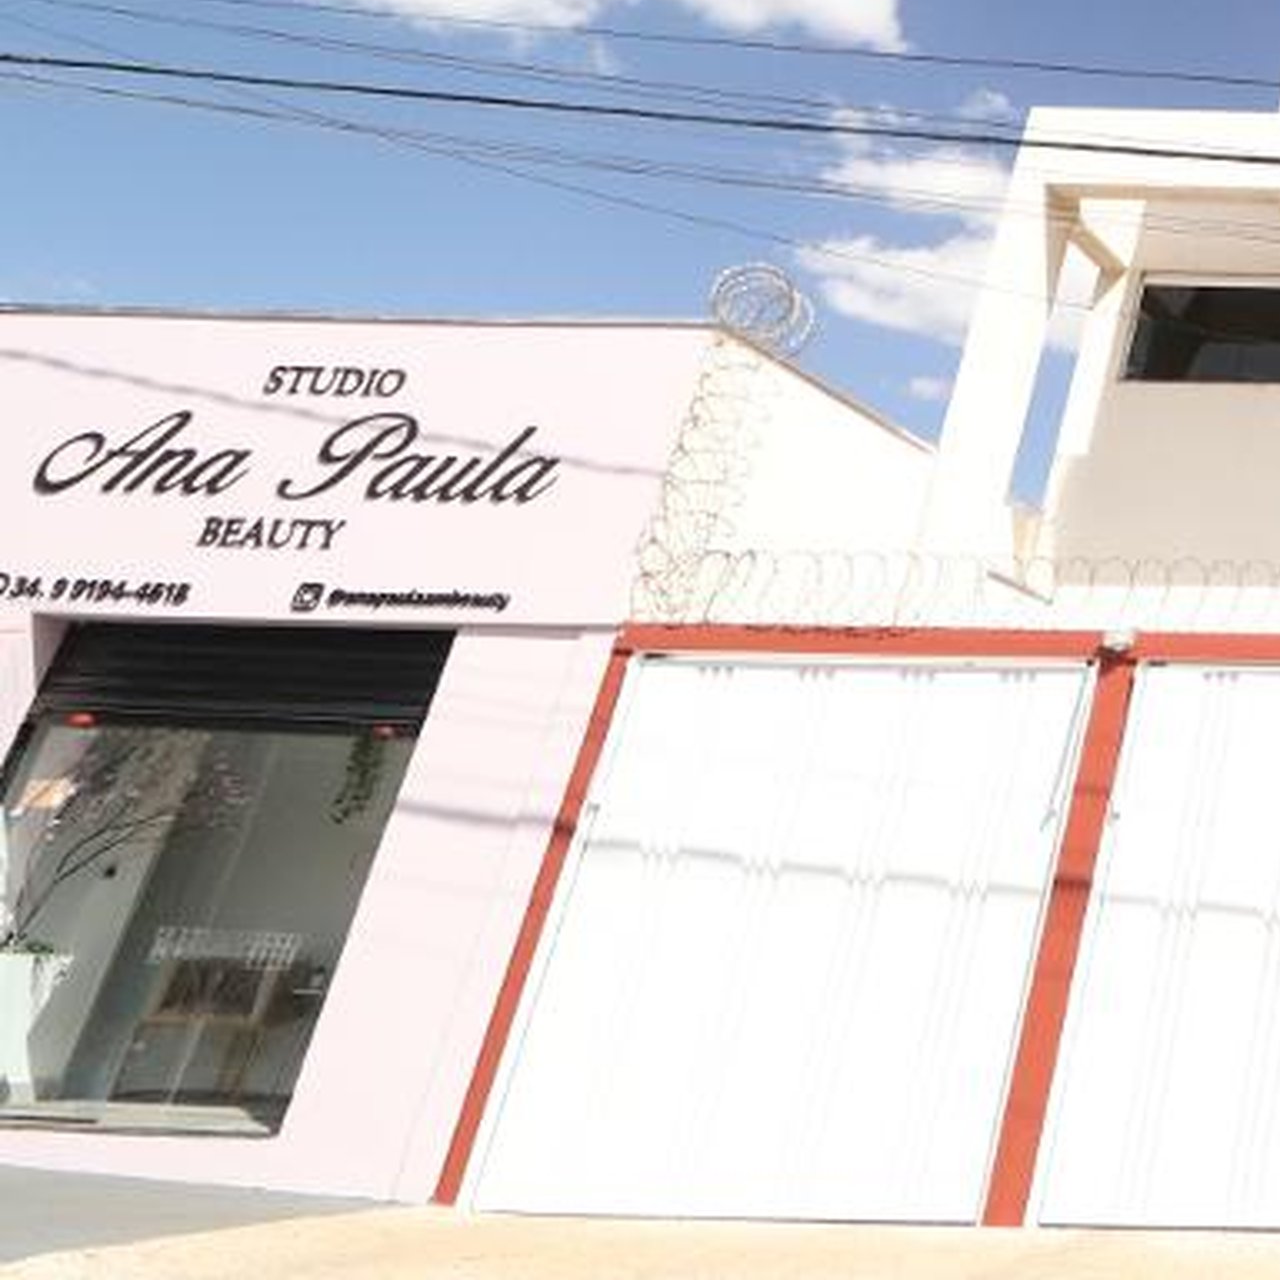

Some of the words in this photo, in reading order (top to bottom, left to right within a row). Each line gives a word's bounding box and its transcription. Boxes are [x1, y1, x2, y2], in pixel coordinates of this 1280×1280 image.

[263, 366, 406, 398] STUDIO
[33, 410, 252, 496] Ana
[276, 412, 560, 504] Paula
[198, 517, 347, 550] BEAUTY
